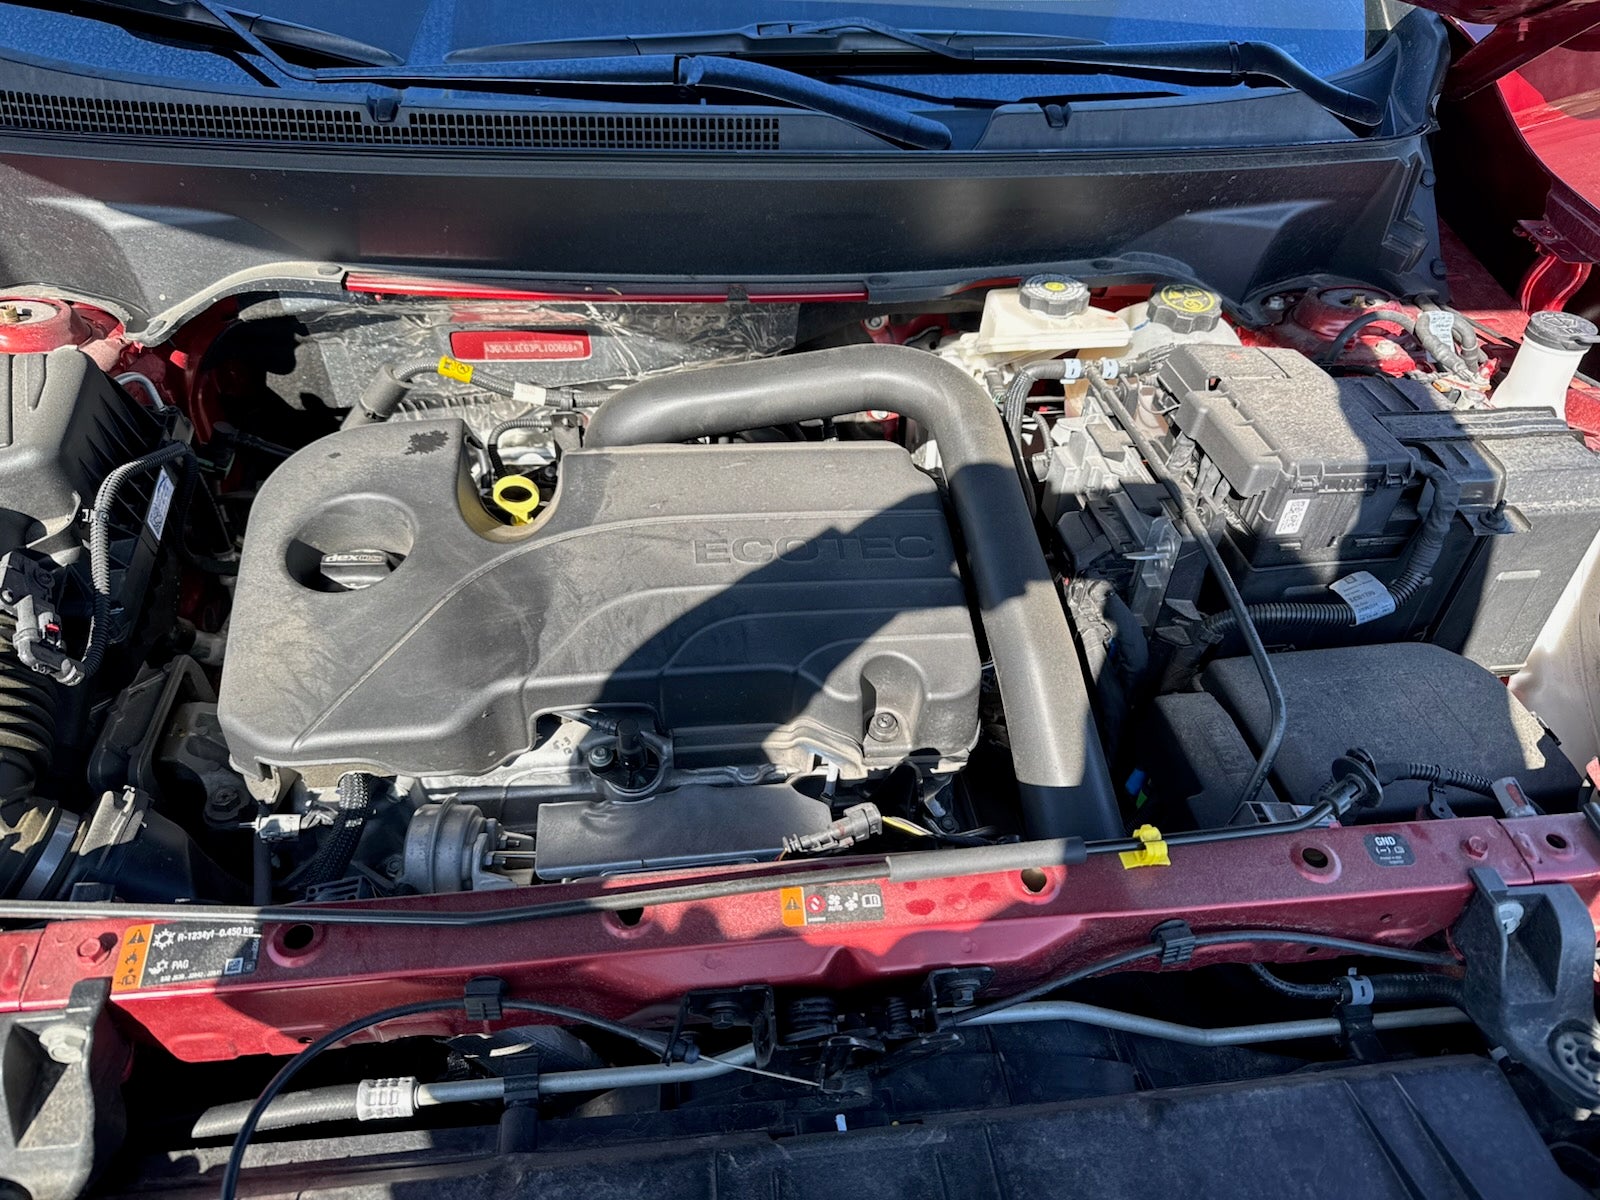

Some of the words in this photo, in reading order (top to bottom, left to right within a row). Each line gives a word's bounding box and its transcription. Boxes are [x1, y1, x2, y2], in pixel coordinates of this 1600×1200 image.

[693, 536, 935, 564] ECOTEC
[1375, 836, 1396, 846] GND
[219, 926, 241, 938] 0.450
